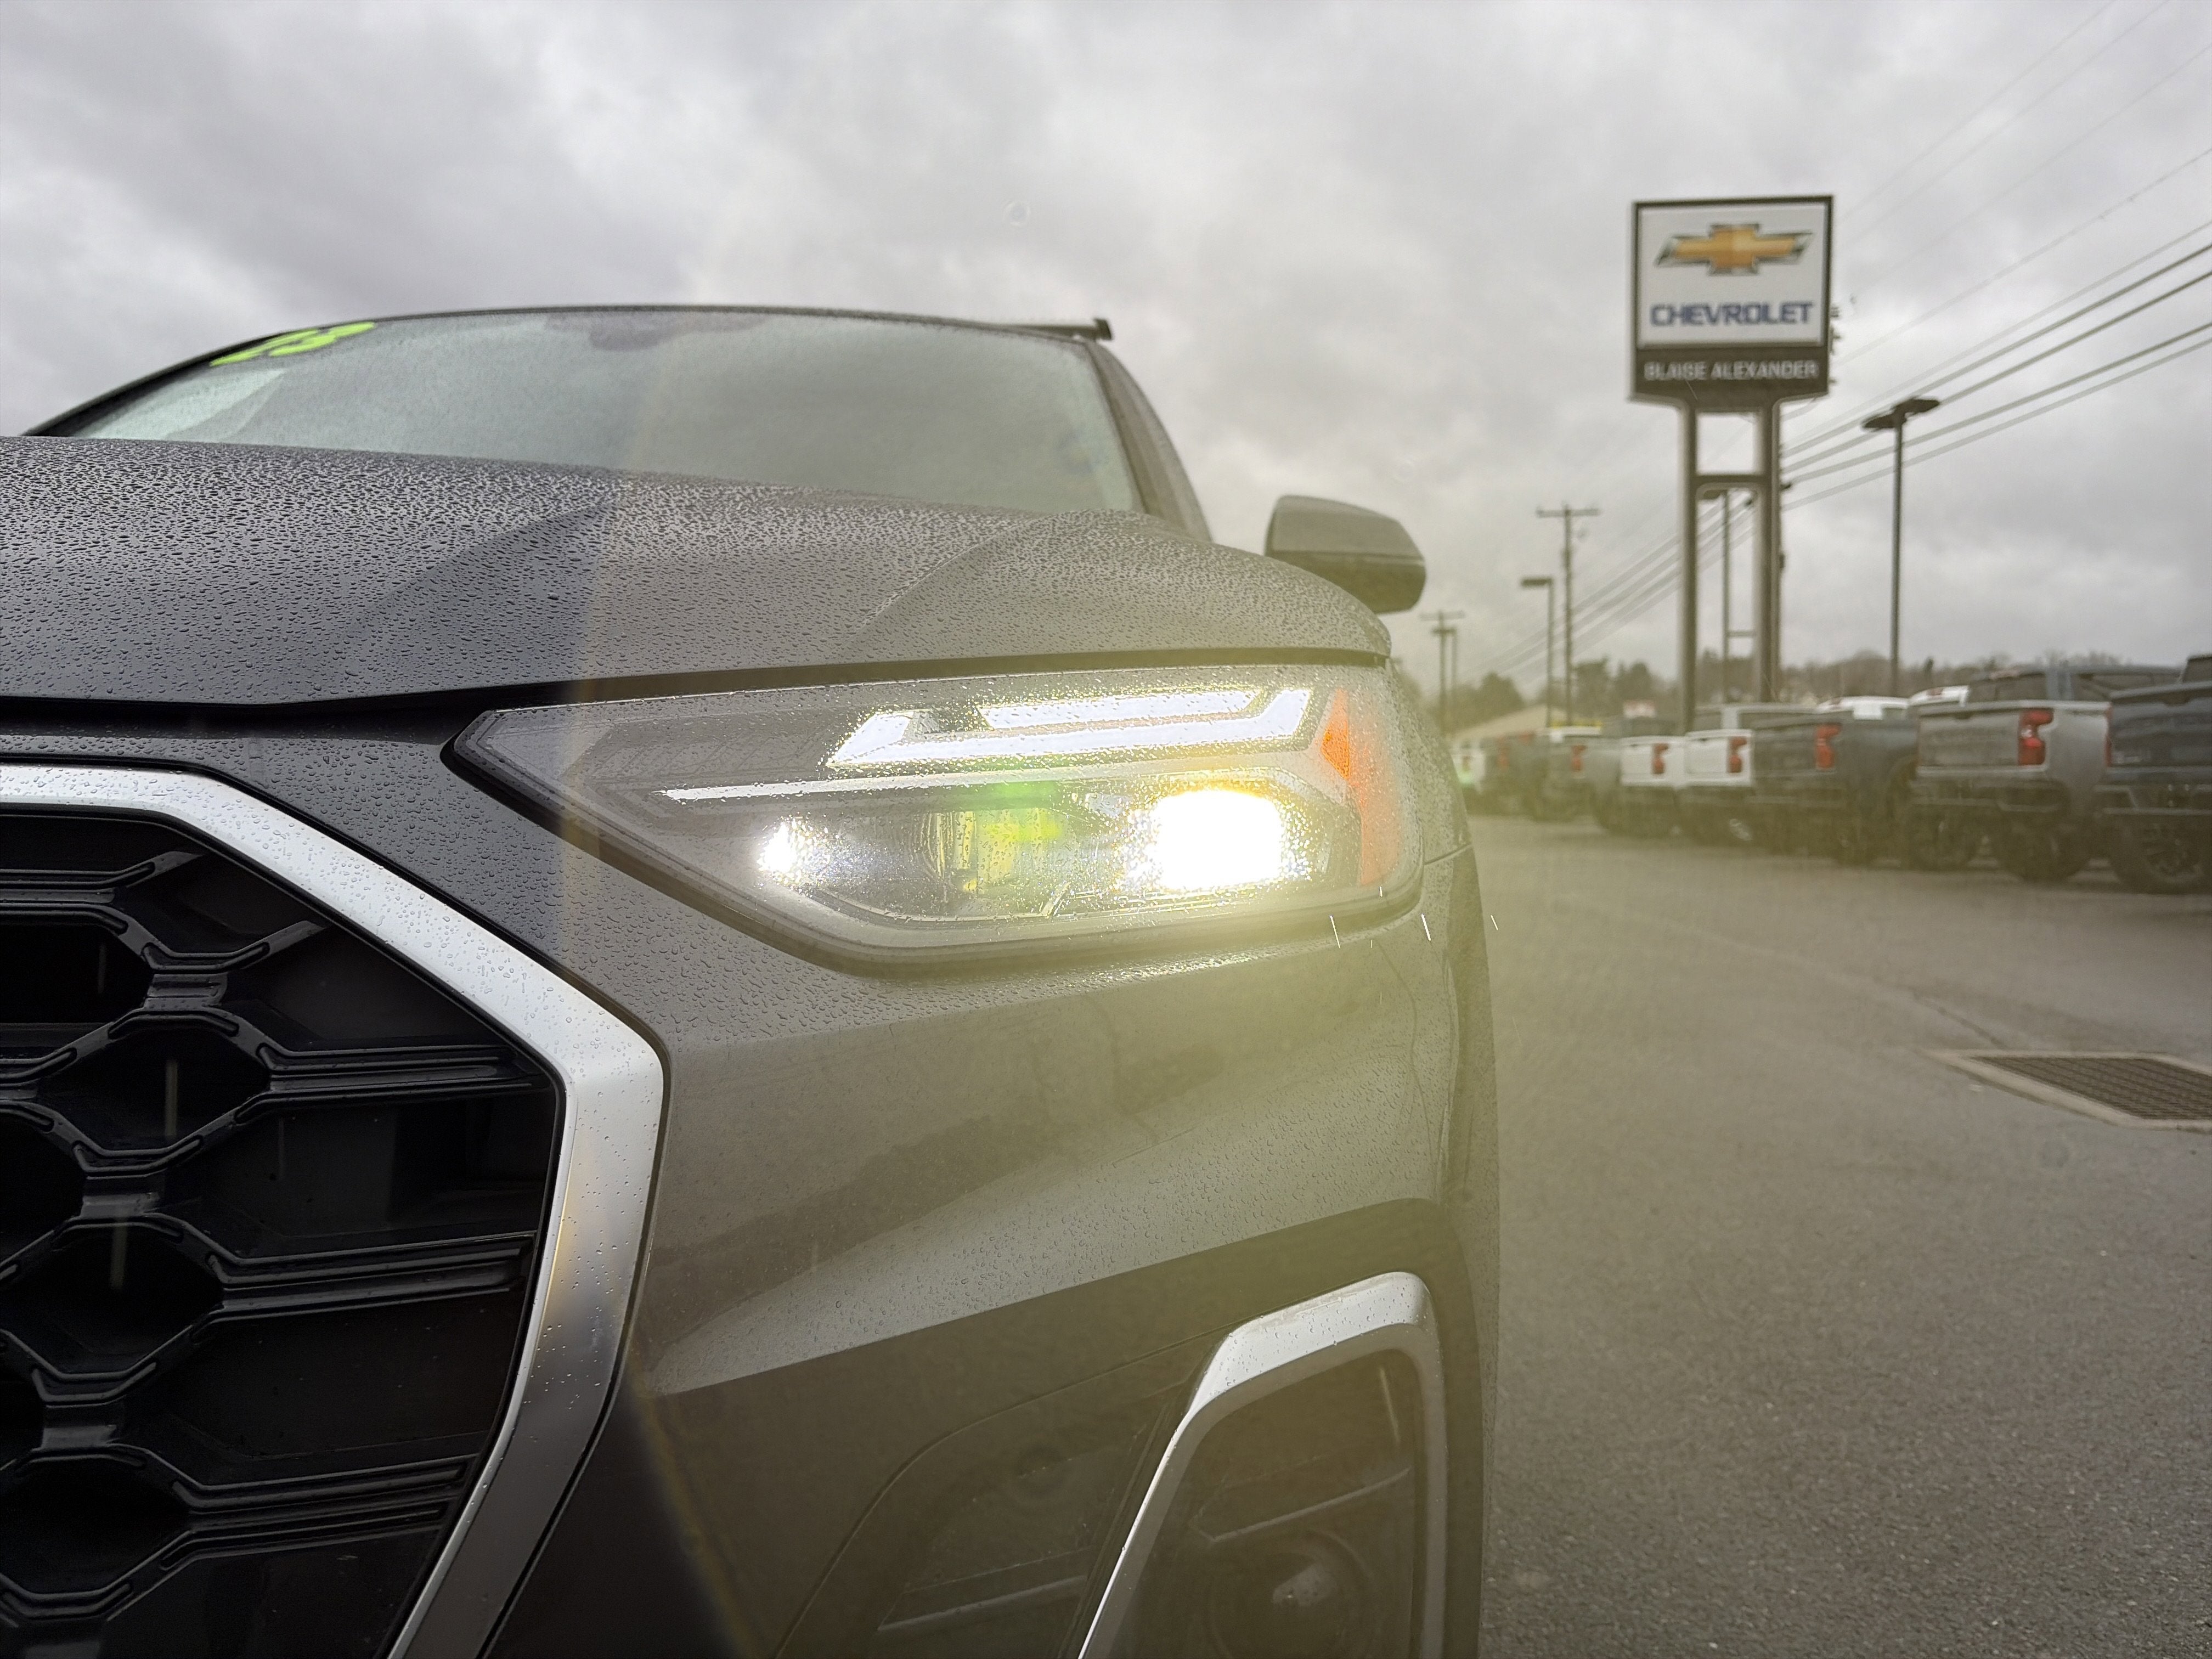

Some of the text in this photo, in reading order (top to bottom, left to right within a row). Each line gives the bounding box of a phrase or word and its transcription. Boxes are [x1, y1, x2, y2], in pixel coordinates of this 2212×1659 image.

[1651, 302, 1813, 326] CHEVROLET
[1646, 360, 1819, 380] BLAISE ALEXANDER
